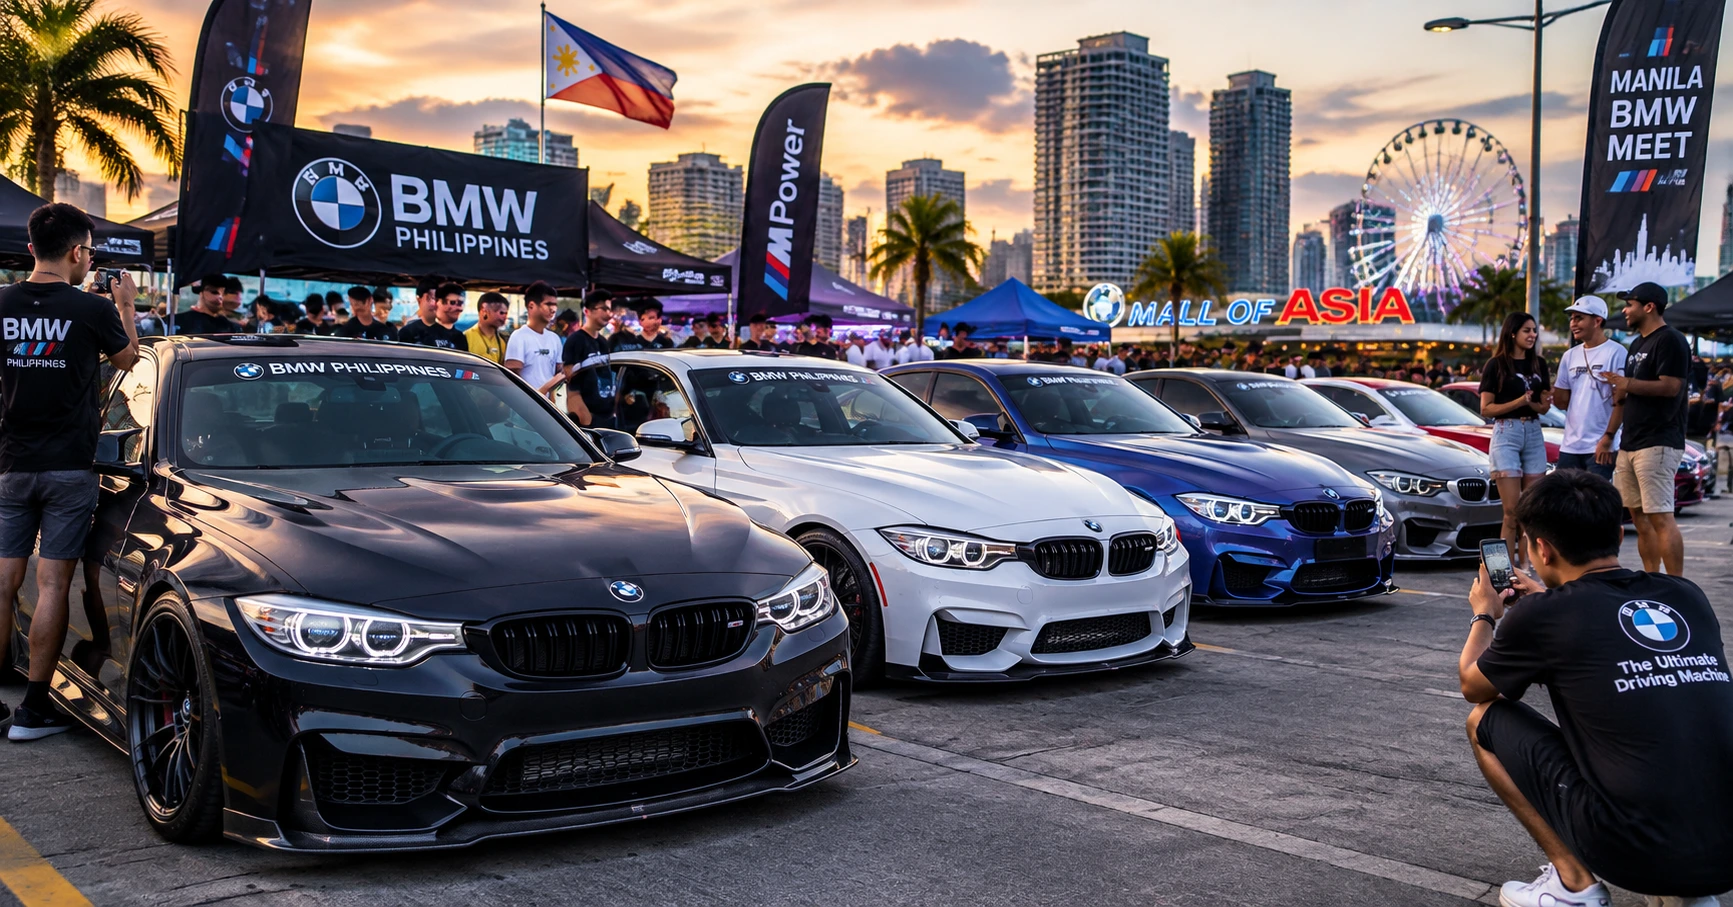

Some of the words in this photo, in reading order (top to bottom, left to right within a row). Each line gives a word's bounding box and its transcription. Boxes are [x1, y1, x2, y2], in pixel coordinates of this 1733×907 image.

[1609, 65, 1703, 94] MANILA
[1609, 96, 1698, 129] BMW
[1606, 131, 1693, 162] MEET
[390, 173, 538, 234] BMW
[395, 226, 550, 261] PHILIPPINES
[1128, 300, 1217, 327] MALL
[1226, 298, 1276, 326] OF
[1274, 286, 1416, 326] ASIA
[2, 317, 73, 342] BMW
[268, 362, 325, 375] BMW
[330, 361, 452, 379] PHILIPPINES
[749, 371, 788, 382] BMW
[1617, 659, 1653, 675] The
[1655, 652, 1719, 669] Ultimate
[1614, 672, 1678, 693] Driving
[1677, 667, 1731, 683] Machine
